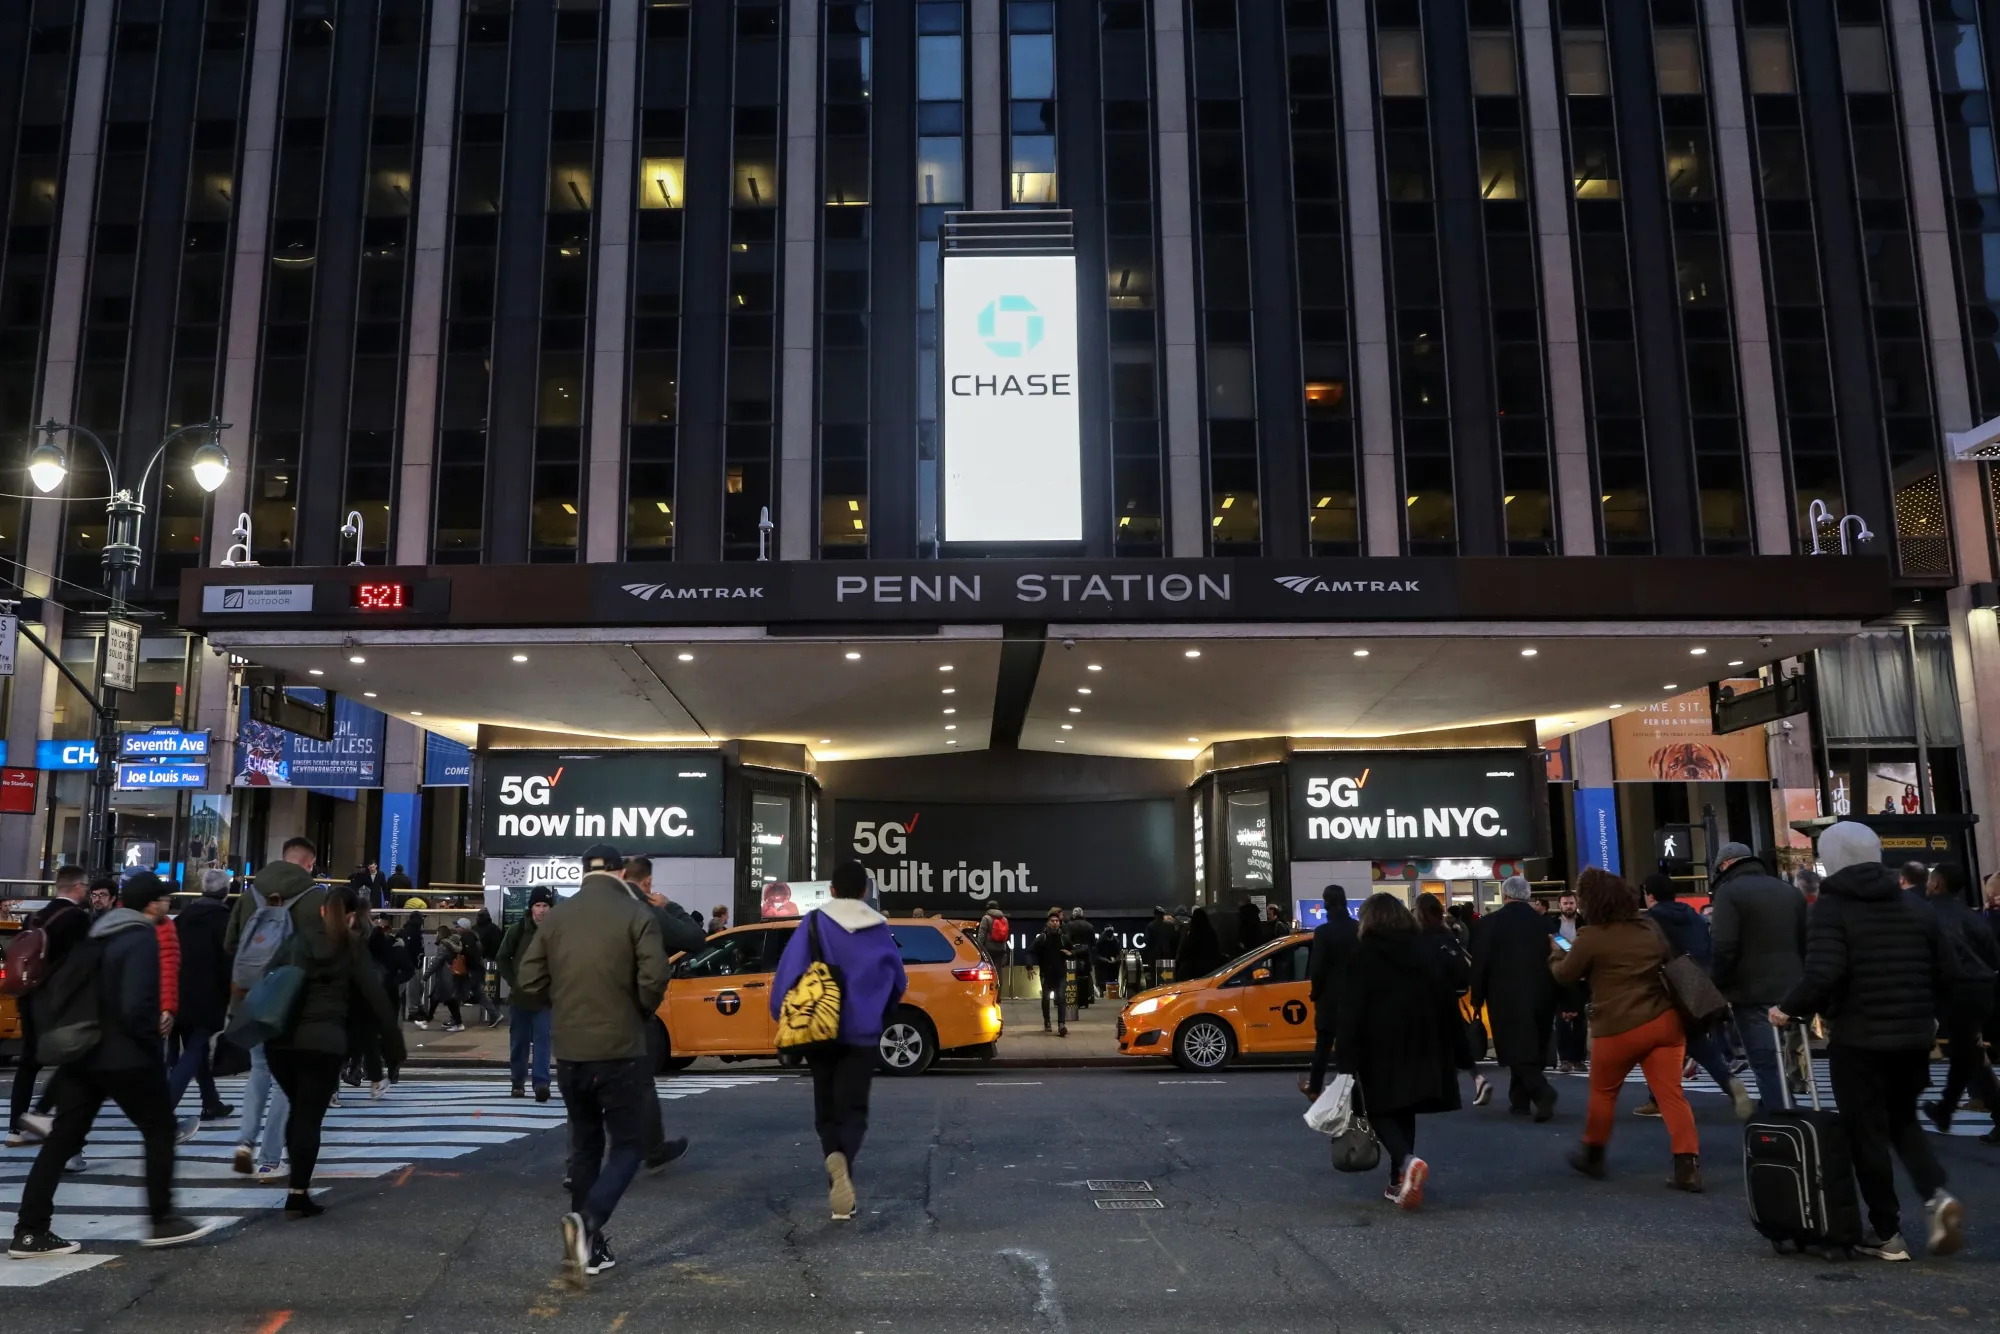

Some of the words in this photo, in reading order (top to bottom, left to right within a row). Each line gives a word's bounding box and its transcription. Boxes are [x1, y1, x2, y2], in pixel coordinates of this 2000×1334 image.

[952, 374, 1071, 396] CHASE
[659, 587, 764, 599] AMTRAK
[836, 575, 981, 602] PENN
[1016, 573, 1230, 602] STATION
[1314, 580, 1420, 593] AMTRAK
[360, 585, 402, 608] 5:21
[110, 628, 135, 642] UNLAWFUL
[111, 638, 118, 647] TO
[119, 640, 134, 652] CROSS
[109, 649, 123, 660] SOLID
[124, 652, 134, 663] LINE
[117, 662, 125, 671] ON
[121, 675, 132, 685] SIDE
[1679, 702, 1704, 712] SIT.
[1644, 718, 1659, 726] FEB
[1661, 718, 1670, 726] 10
[126, 738, 177, 752] Seventh
[180, 738, 204, 751] Ave
[293, 738, 376, 754] RELENTLESS.
[248, 755, 279, 776] CHASE
[292, 766, 358, 774] NEWYORKRANGERS.COM
[444, 767, 470, 776] COME
[126, 771, 146, 783] Joe
[149, 769, 179, 783] Louis
[182, 774, 199, 782] Plaza
[11, 780, 34, 788] Standing
[500, 775, 550, 806] 5G
[1306, 777, 1359, 808] 5G
[498, 813, 570, 836] now
[575, 807, 605, 837] in
[611, 806, 694, 837] NYC.
[1308, 816, 1381, 840] now
[1386, 808, 1418, 839] in
[1423, 806, 1507, 839] NYC.
[853, 821, 907, 855] 5G
[528, 861, 580, 883] juice
[942, 861, 1038, 900] right.
[721, 995, 735, 1013] T
[1287, 1004, 1301, 1022] T
